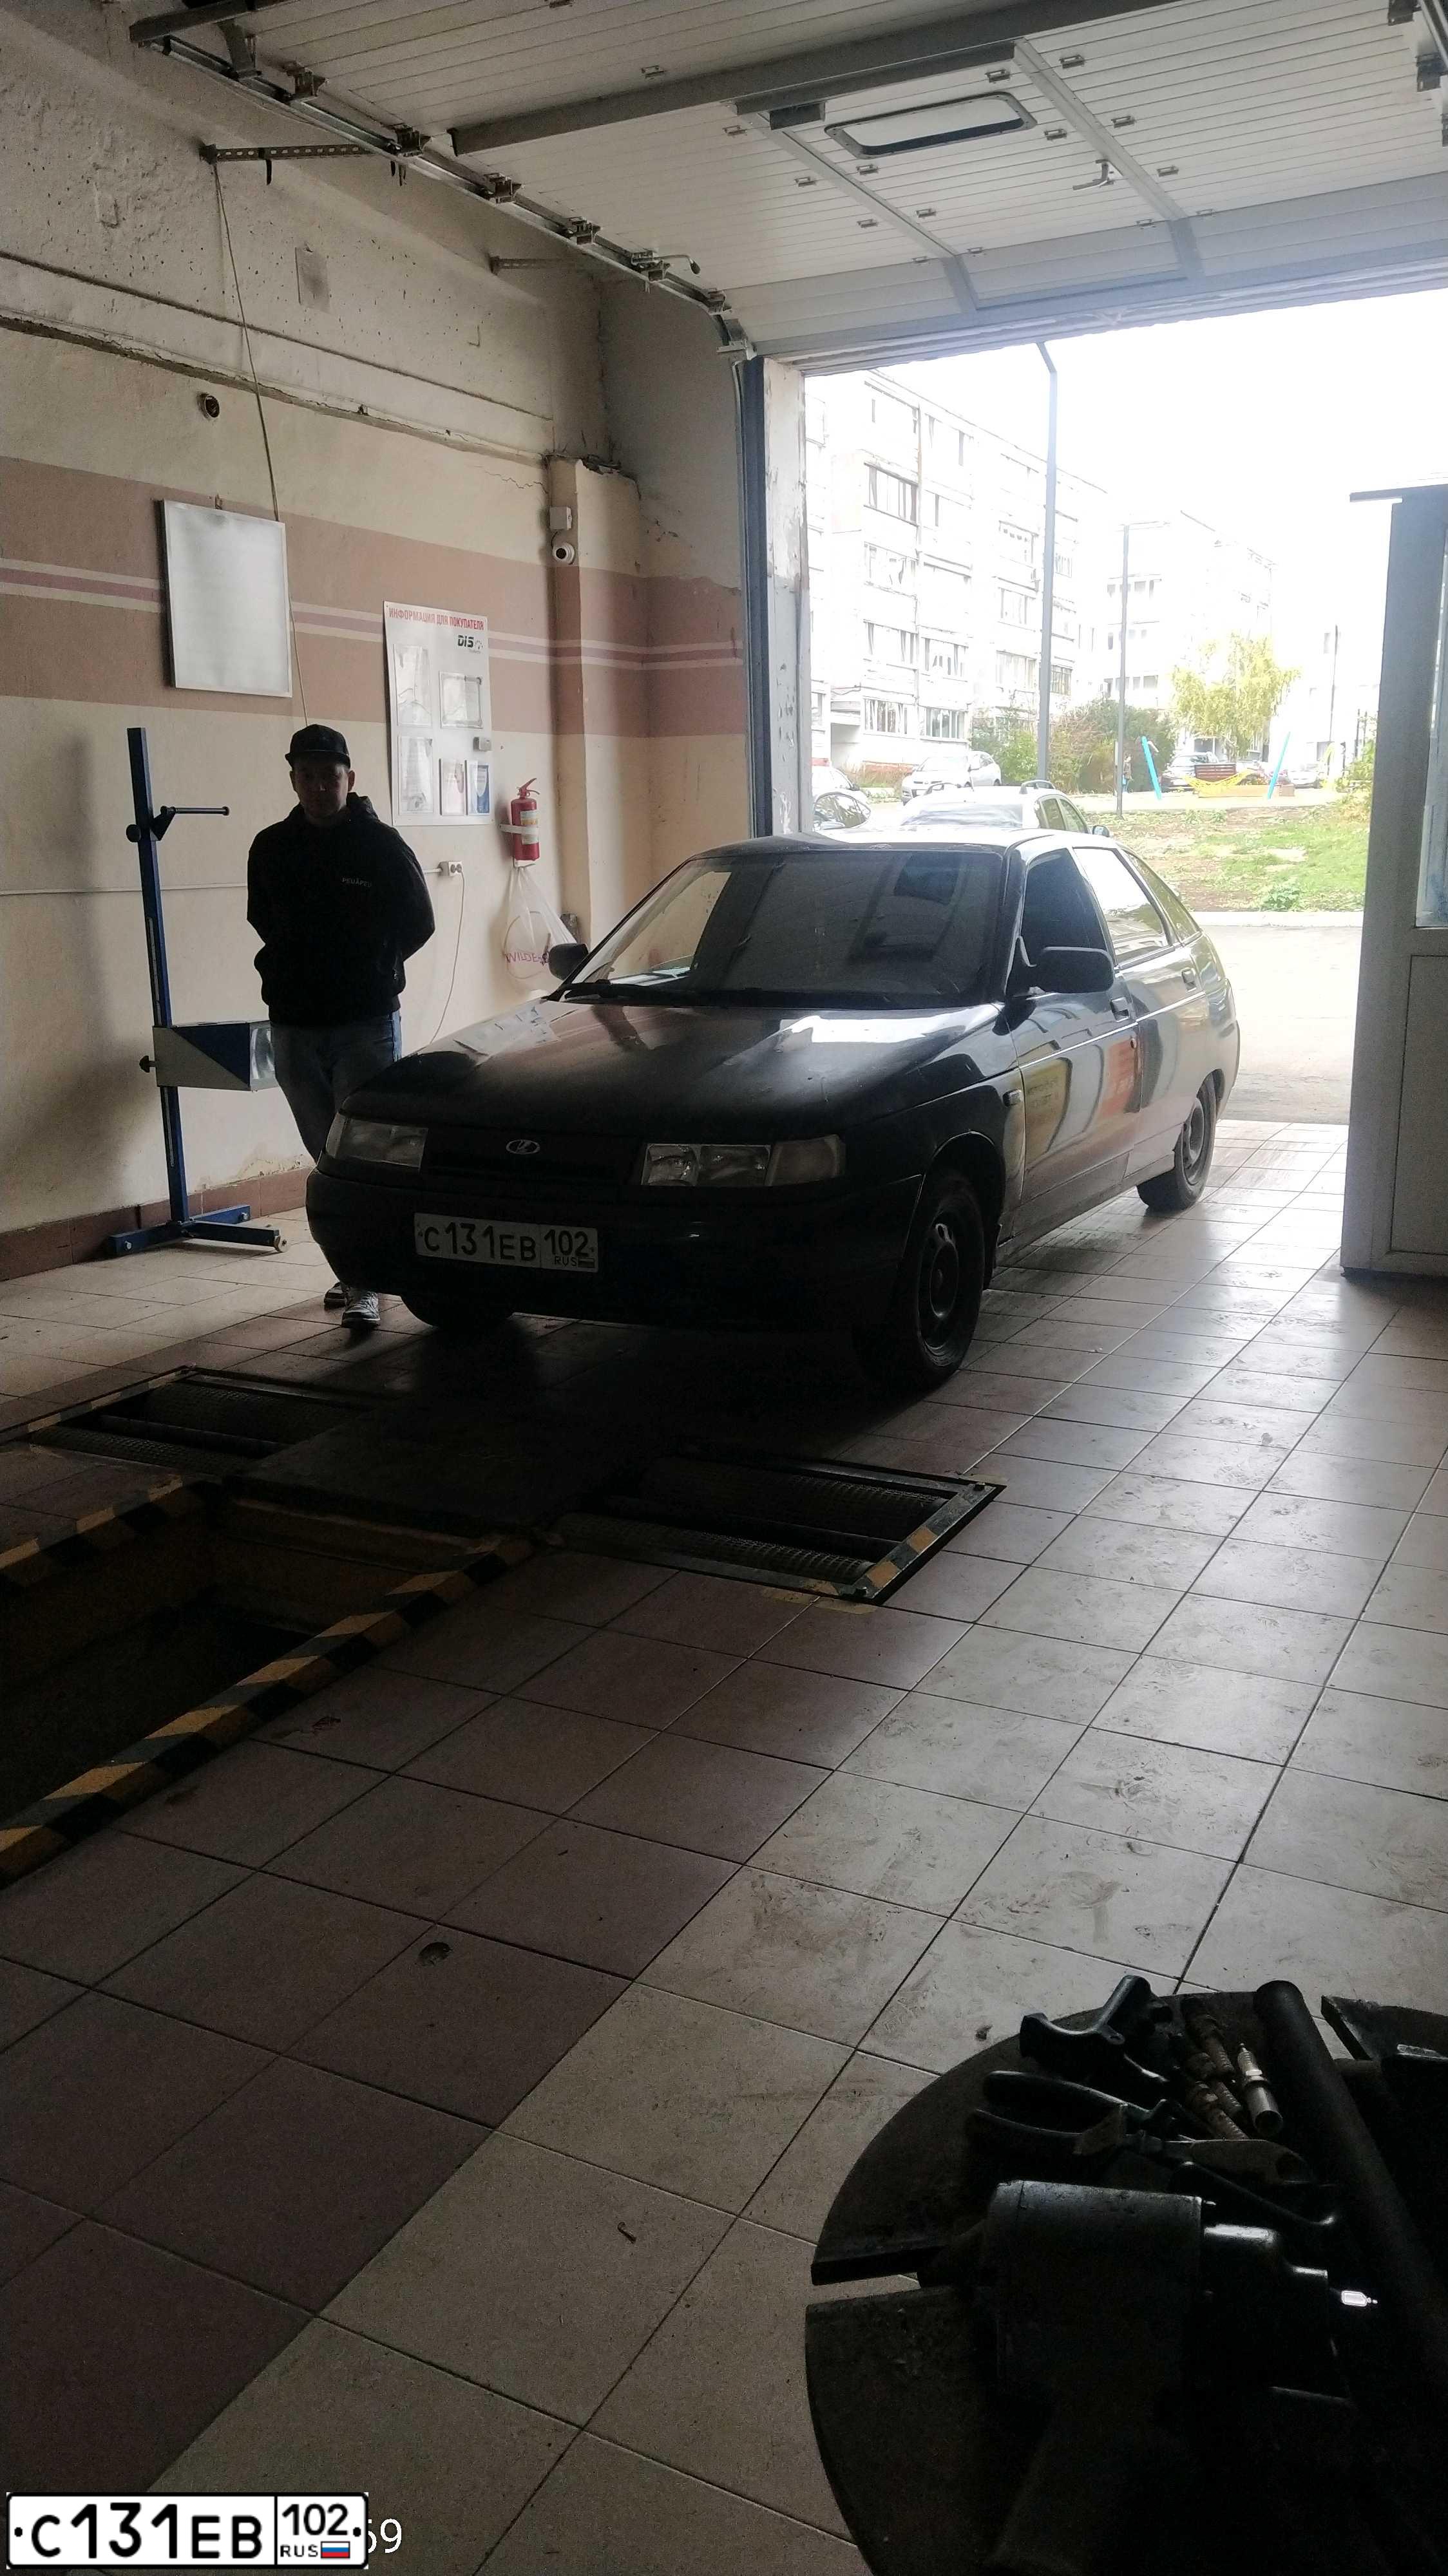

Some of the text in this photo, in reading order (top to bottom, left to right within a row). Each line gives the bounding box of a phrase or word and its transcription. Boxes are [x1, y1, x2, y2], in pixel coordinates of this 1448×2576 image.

[388, 607, 484, 630] ИНФОРМАЦИЯ ДЛЯ ПОКУПАТЕЛЯ
[424, 1222, 589, 1262] С131ЕВ 102
[554, 1255, 577, 1267] RUS
